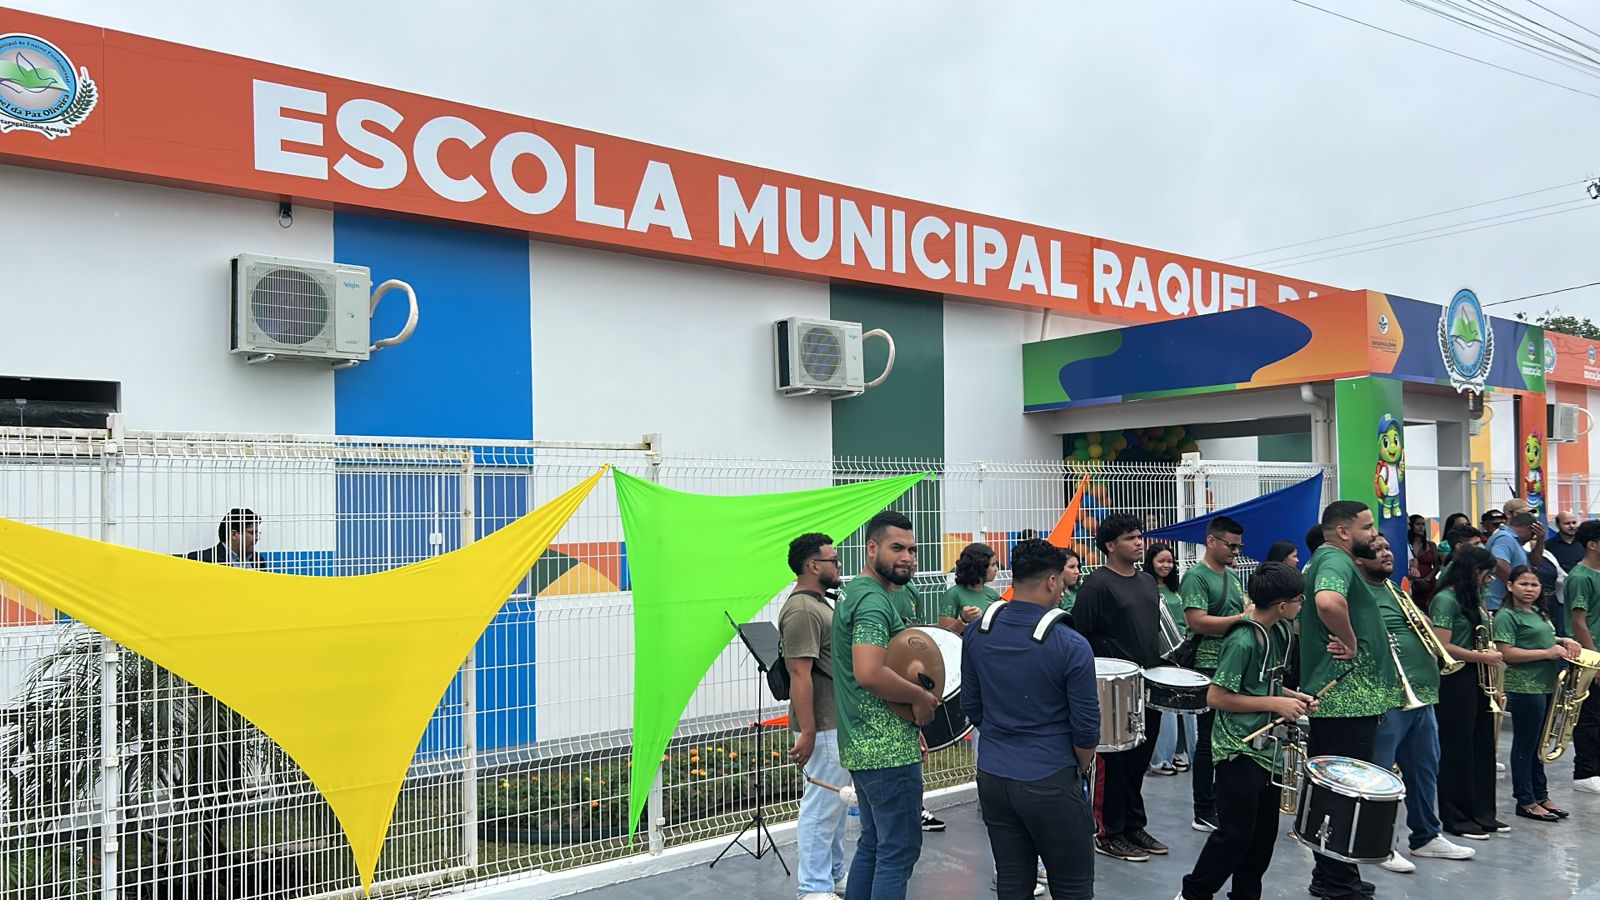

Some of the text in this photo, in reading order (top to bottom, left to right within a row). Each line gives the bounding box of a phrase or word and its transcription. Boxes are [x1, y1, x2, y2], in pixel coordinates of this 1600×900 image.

[11, 107, 22, 115] da
[25, 110, 43, 118] Paz
[42, 94, 70, 116] Oliveira
[252, 78, 691, 241] ESCOLA
[717, 174, 1078, 300] MUNICIPAL
